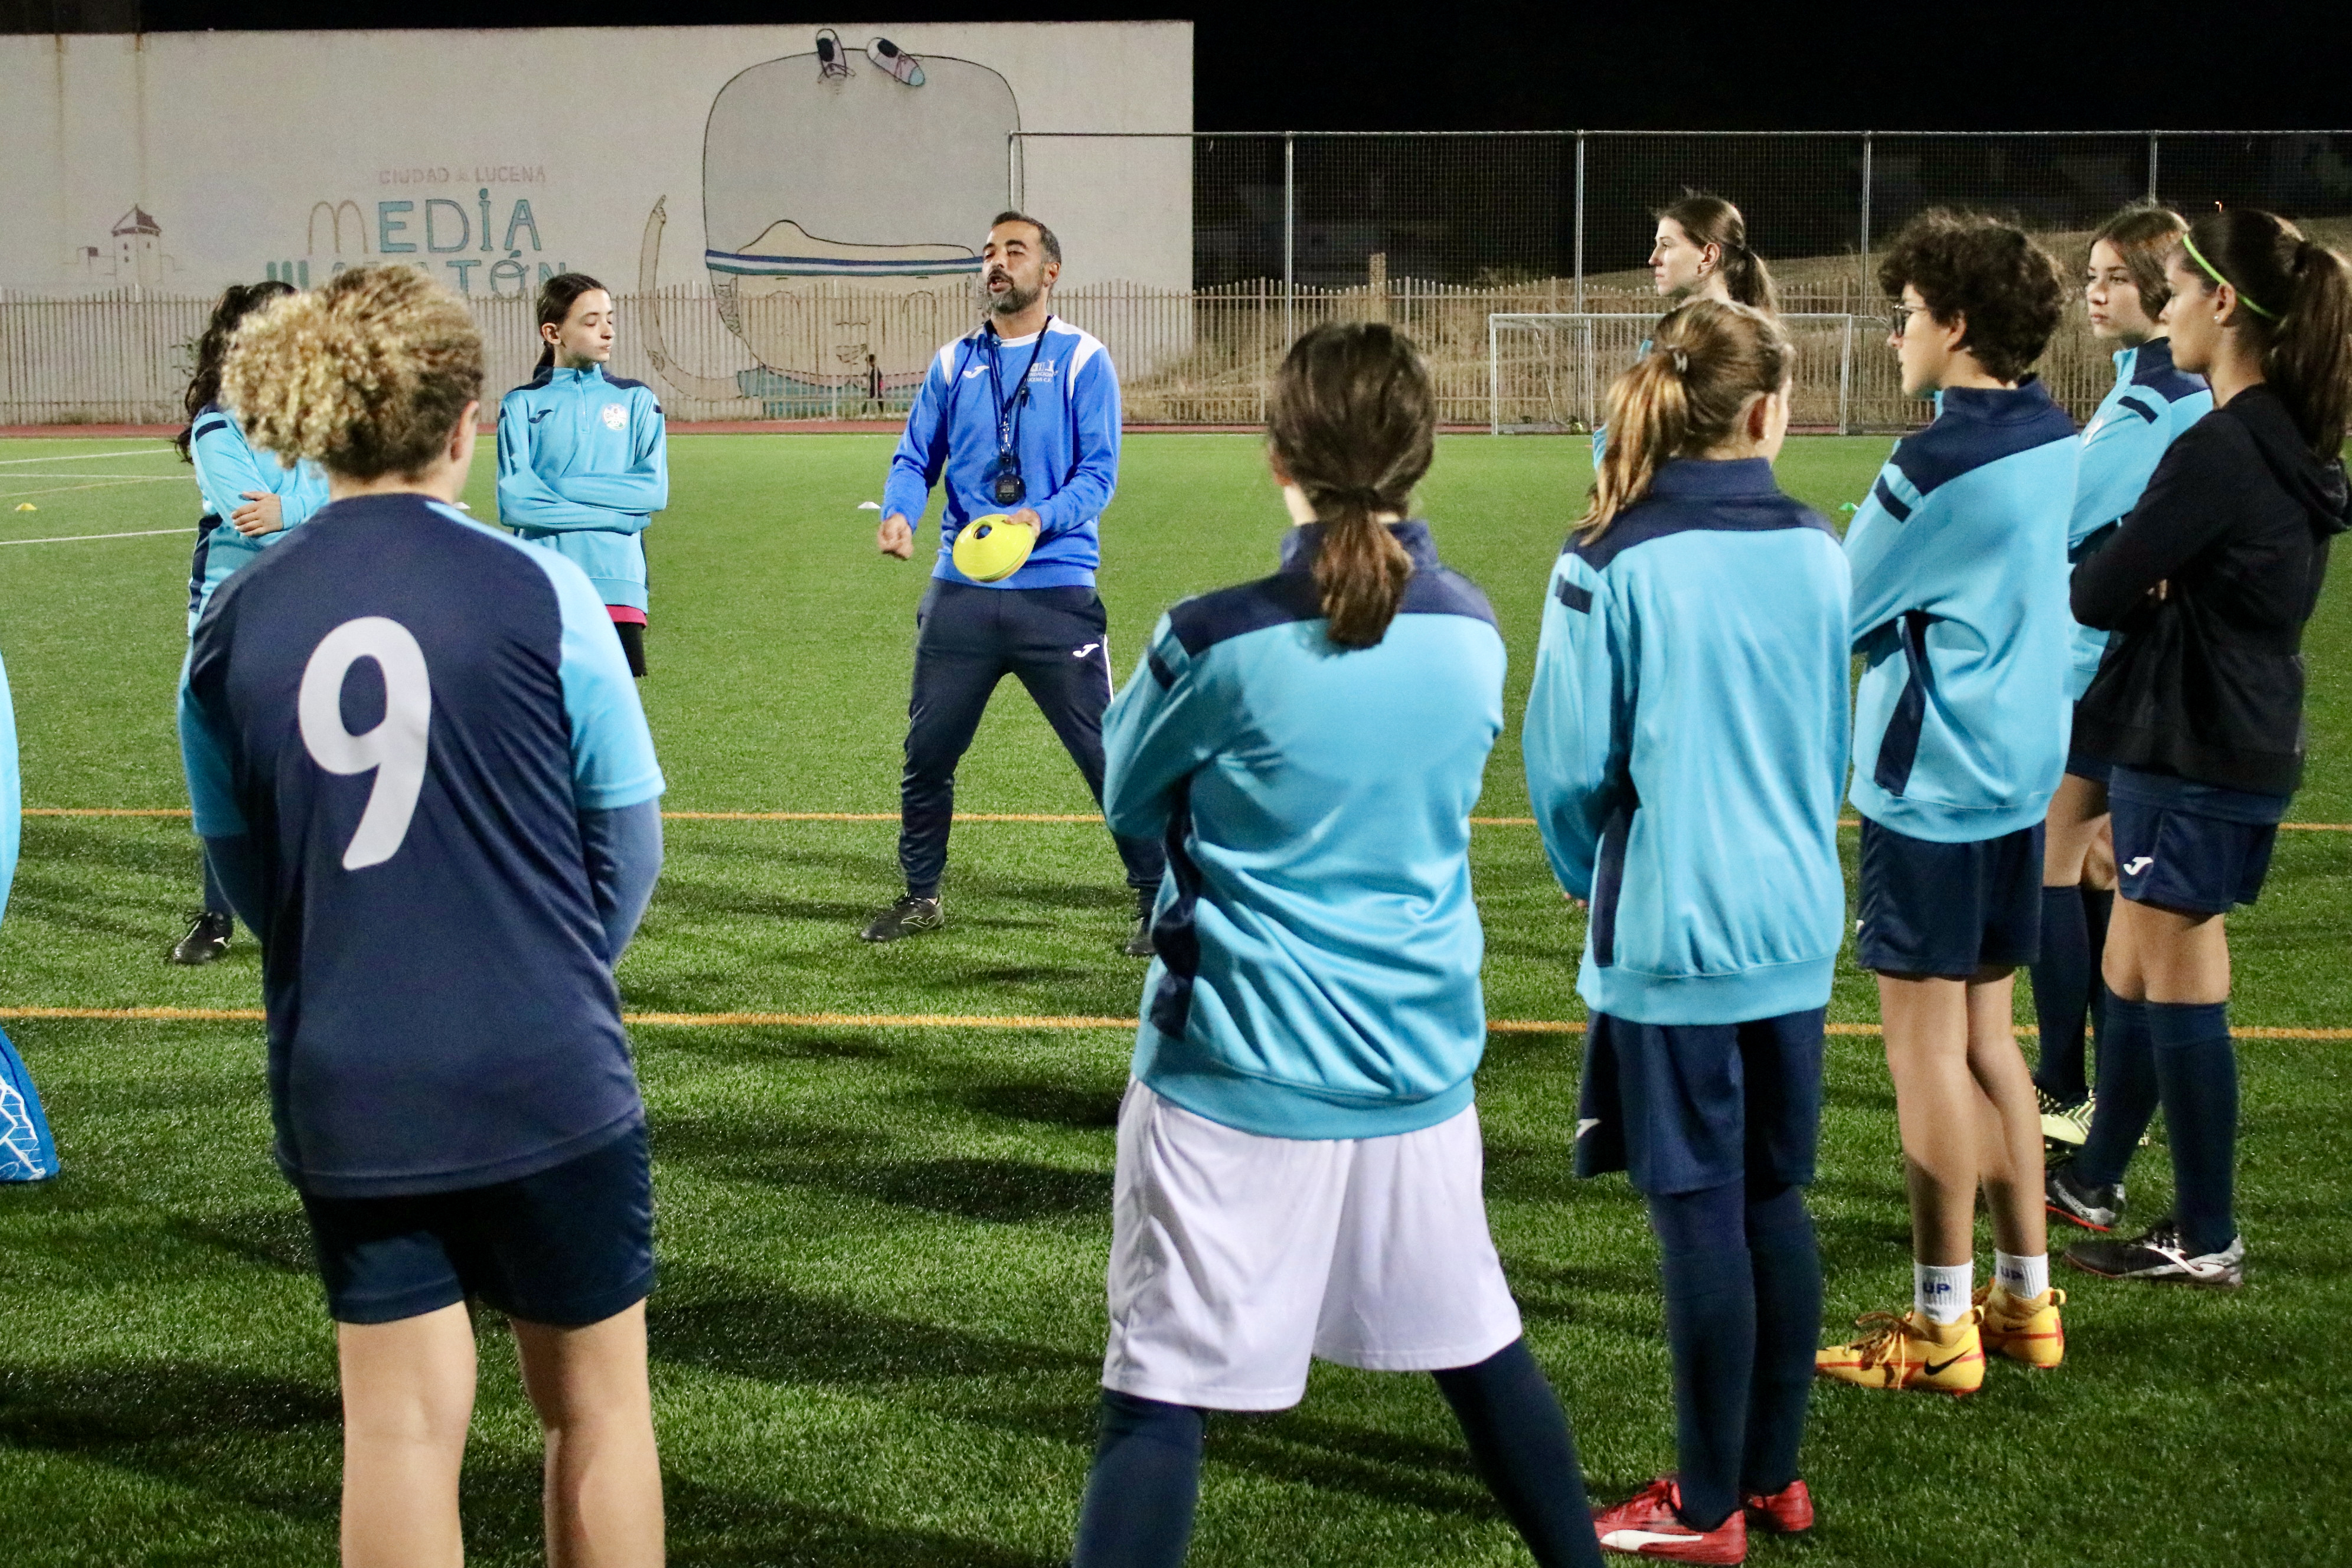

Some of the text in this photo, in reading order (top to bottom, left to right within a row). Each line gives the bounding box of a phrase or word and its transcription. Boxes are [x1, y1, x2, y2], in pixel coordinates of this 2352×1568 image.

[379, 167, 450, 185] CIUDAD
[475, 165, 545, 184] LUCENA
[298, 616, 432, 871] 9
[1923, 1282, 1951, 1295] UP
